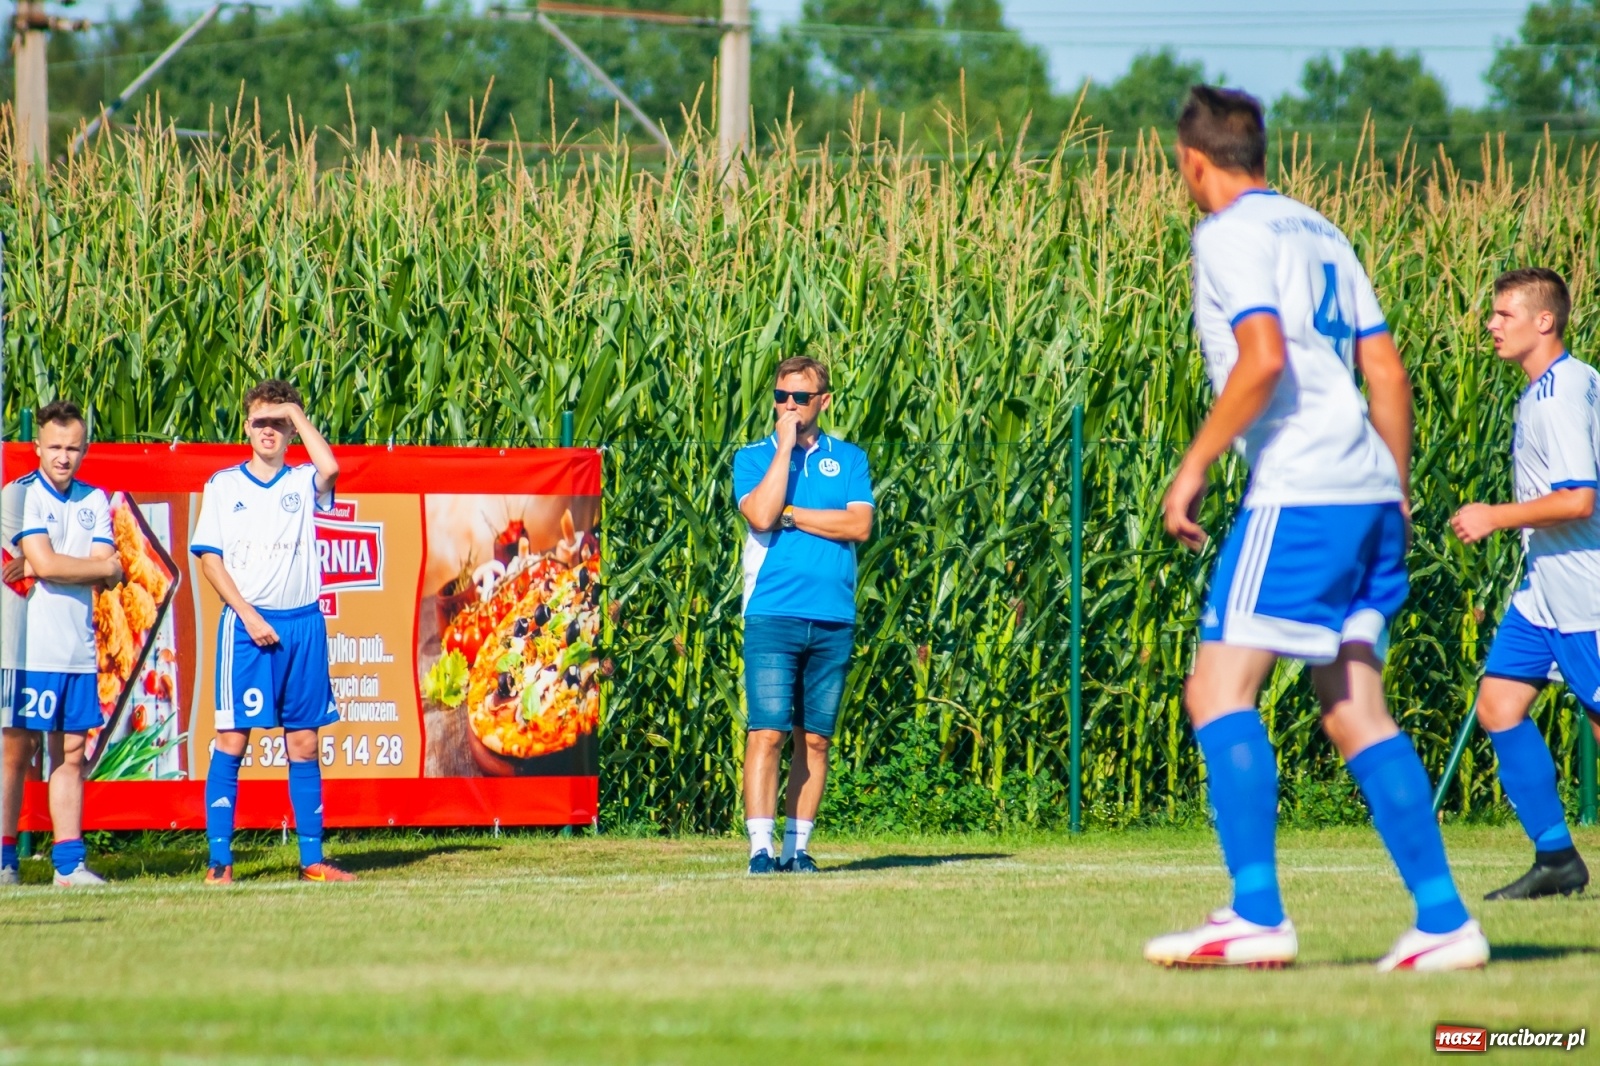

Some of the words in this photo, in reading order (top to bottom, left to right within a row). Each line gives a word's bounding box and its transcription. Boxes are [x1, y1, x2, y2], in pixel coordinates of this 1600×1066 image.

[1313, 263, 1351, 356] 4
[359, 632, 394, 665] pub...
[360, 673, 379, 698] dań
[18, 687, 57, 720] 20
[243, 687, 264, 718] 9
[339, 702, 347, 722] z
[348, 700, 399, 722] dowozem.
[259, 735, 287, 767] 32
[342, 735, 370, 766] 14
[375, 735, 403, 766] 28
